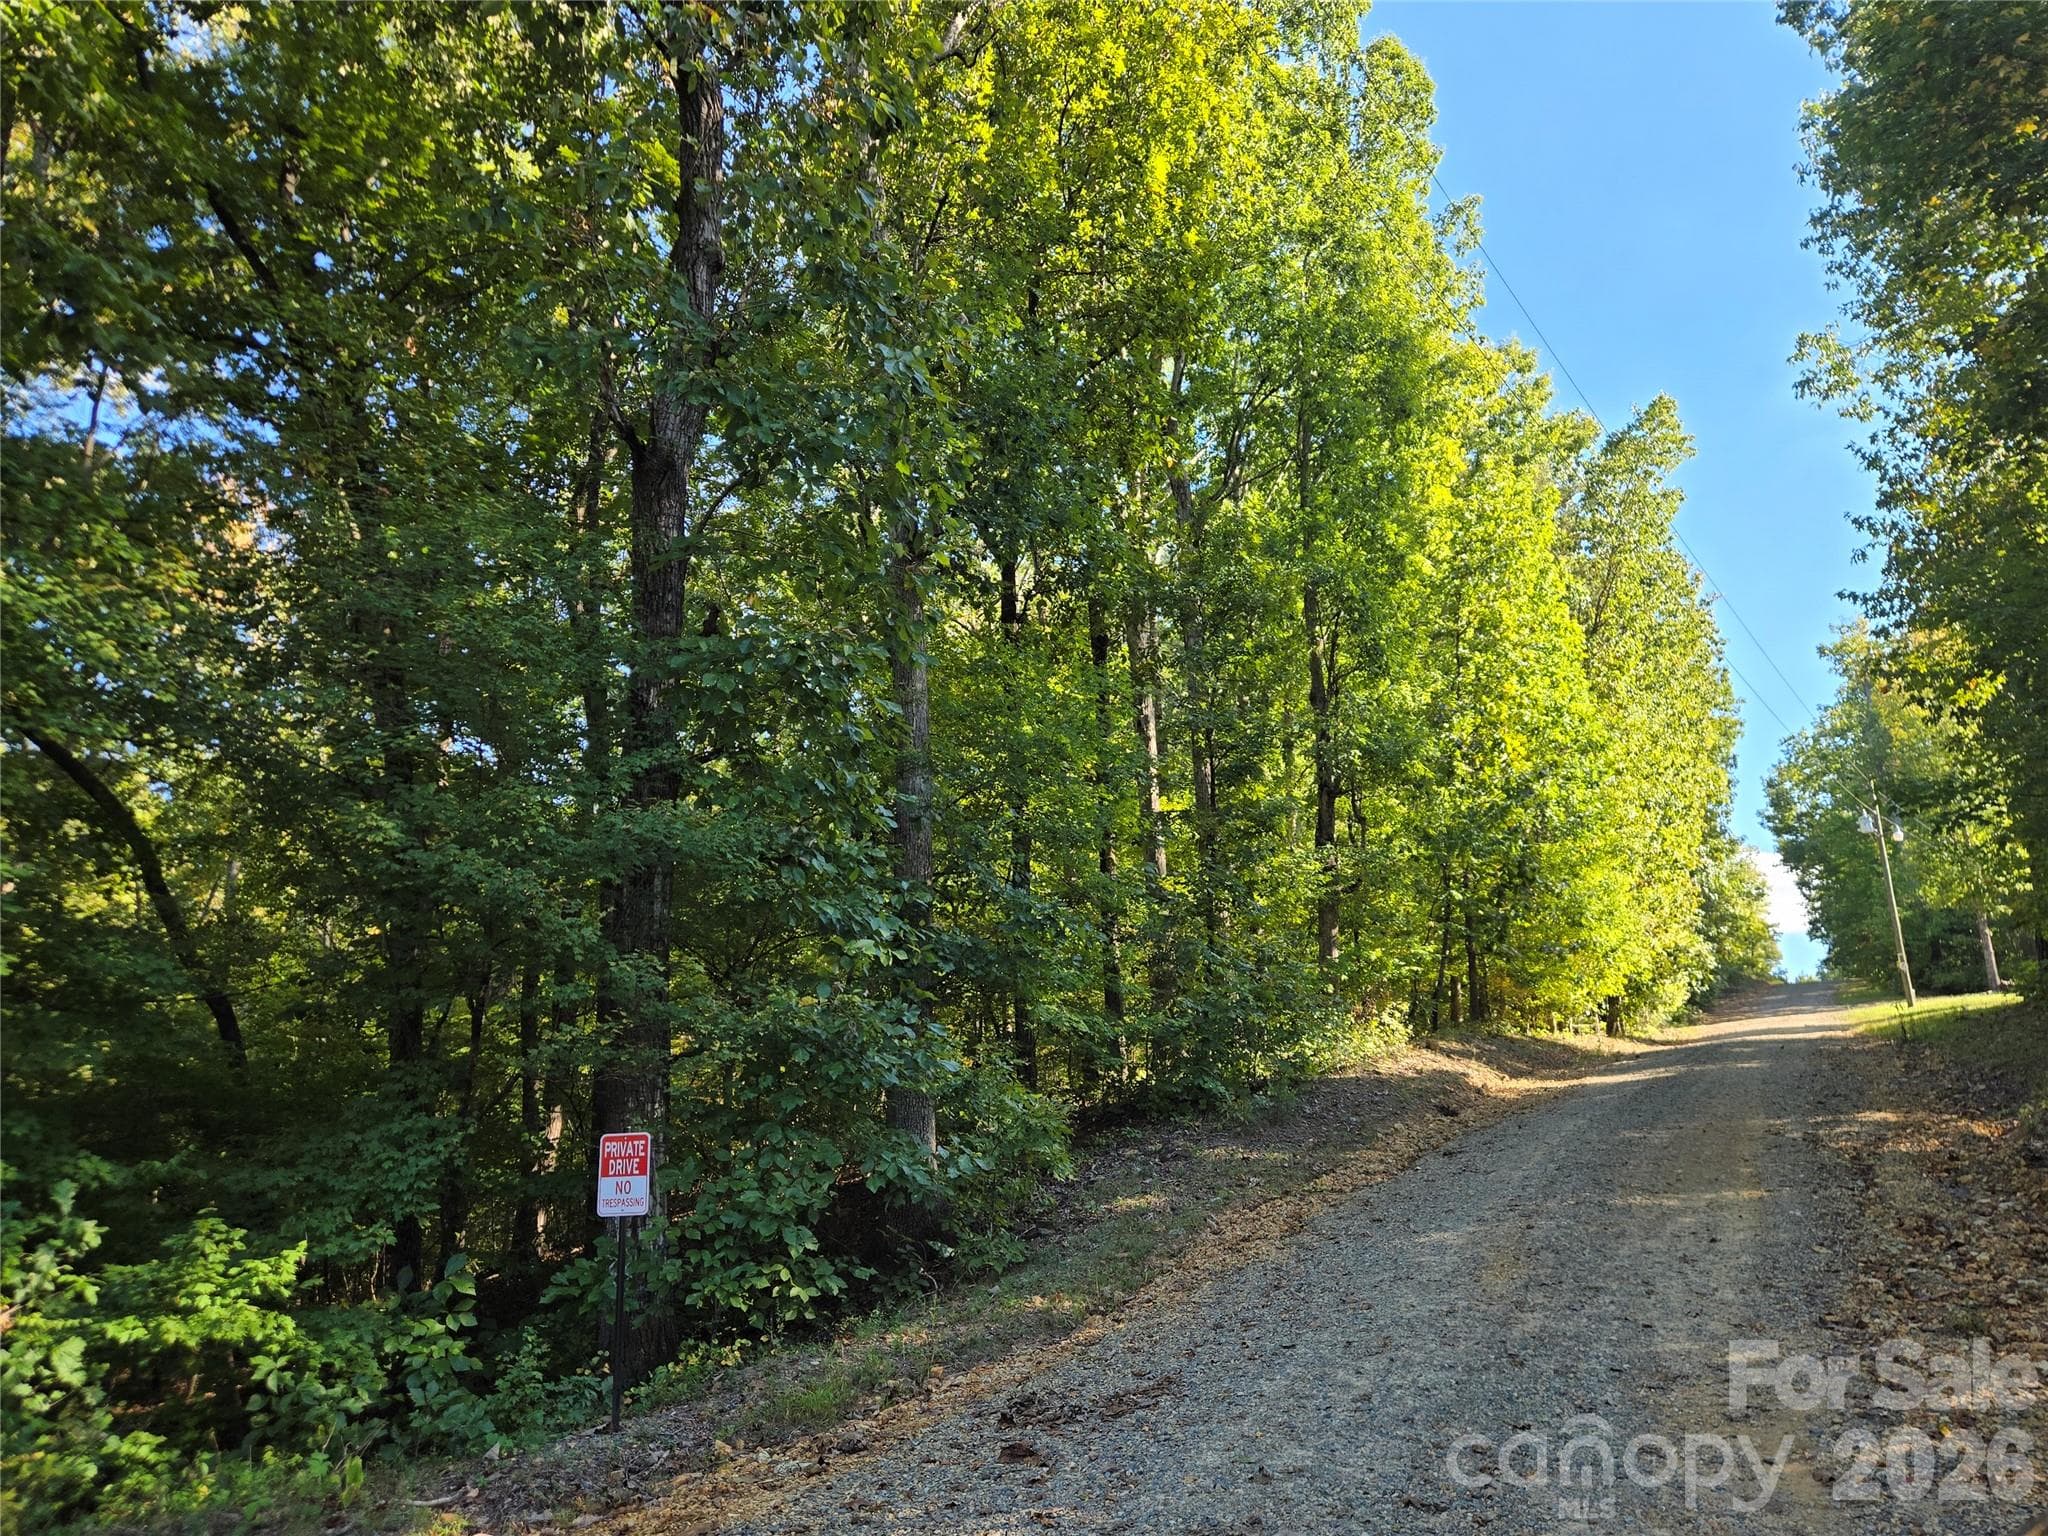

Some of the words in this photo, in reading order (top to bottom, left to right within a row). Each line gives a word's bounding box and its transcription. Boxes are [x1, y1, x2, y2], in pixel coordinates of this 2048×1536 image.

[604, 1140, 645, 1158] PRIVATE
[609, 1158, 640, 1175] DRIVE
[615, 1180, 632, 1195] NO
[602, 1198, 644, 1208] TRESPASSING
